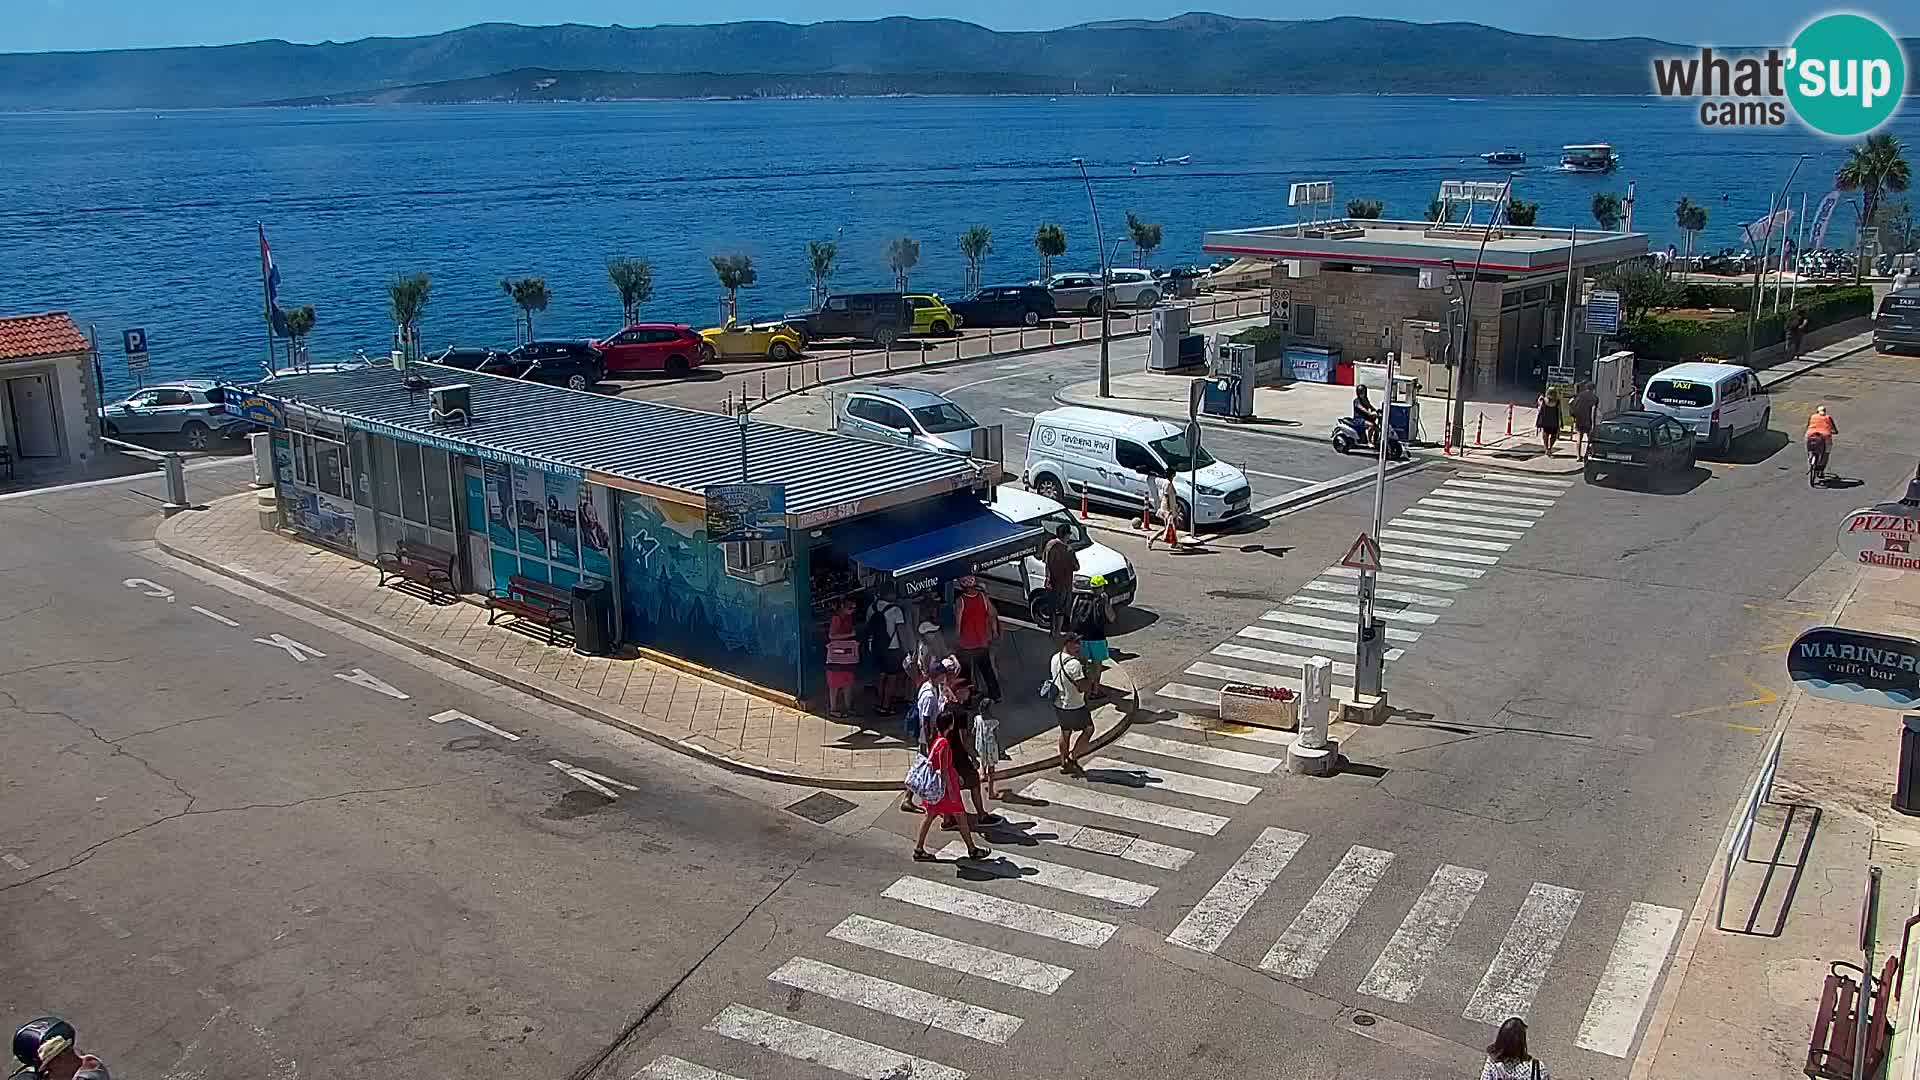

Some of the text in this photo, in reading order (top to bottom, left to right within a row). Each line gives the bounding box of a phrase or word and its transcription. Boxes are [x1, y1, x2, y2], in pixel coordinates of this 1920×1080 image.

[128, 332, 141, 350] P
[1672, 381, 1692, 390] TAXI
[477, 449, 582, 479] BUS STATION TICKET OFFICE
[1828, 662, 1897, 681] caffe bar
